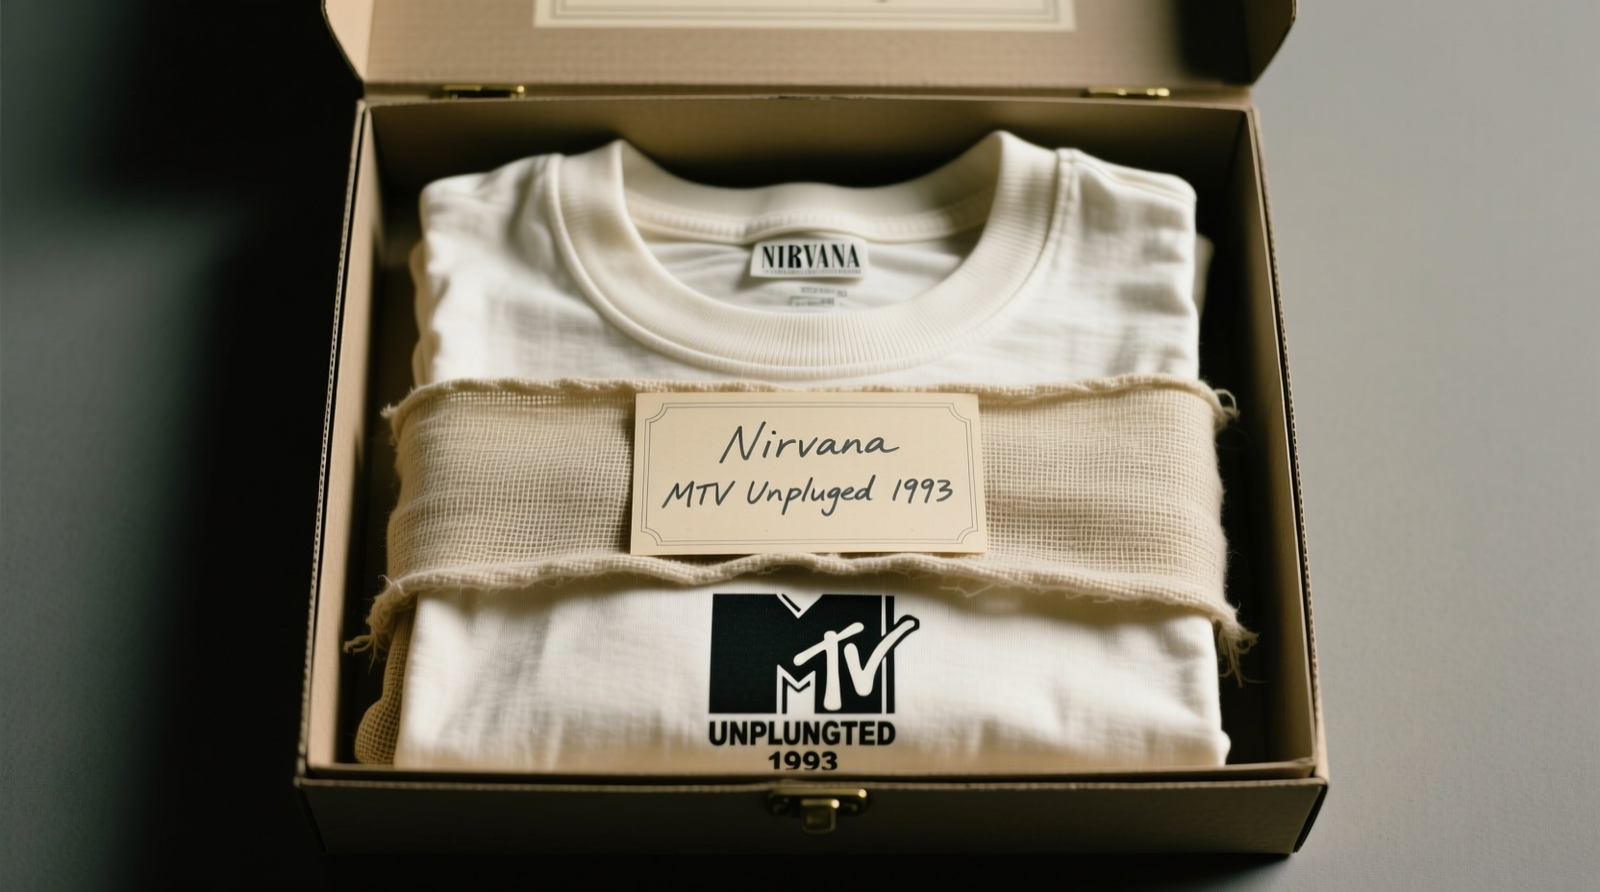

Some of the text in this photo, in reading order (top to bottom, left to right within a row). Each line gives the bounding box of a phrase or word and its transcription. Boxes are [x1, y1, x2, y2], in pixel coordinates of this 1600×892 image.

[762, 243, 861, 269] NIRVANA
[719, 421, 900, 464] Nirvana
[661, 474, 954, 516] MTV Unpluged 1993
[708, 593, 920, 715] MTV
[708, 720, 896, 746] UNPLUNGTED
[768, 751, 838, 771] 1993
